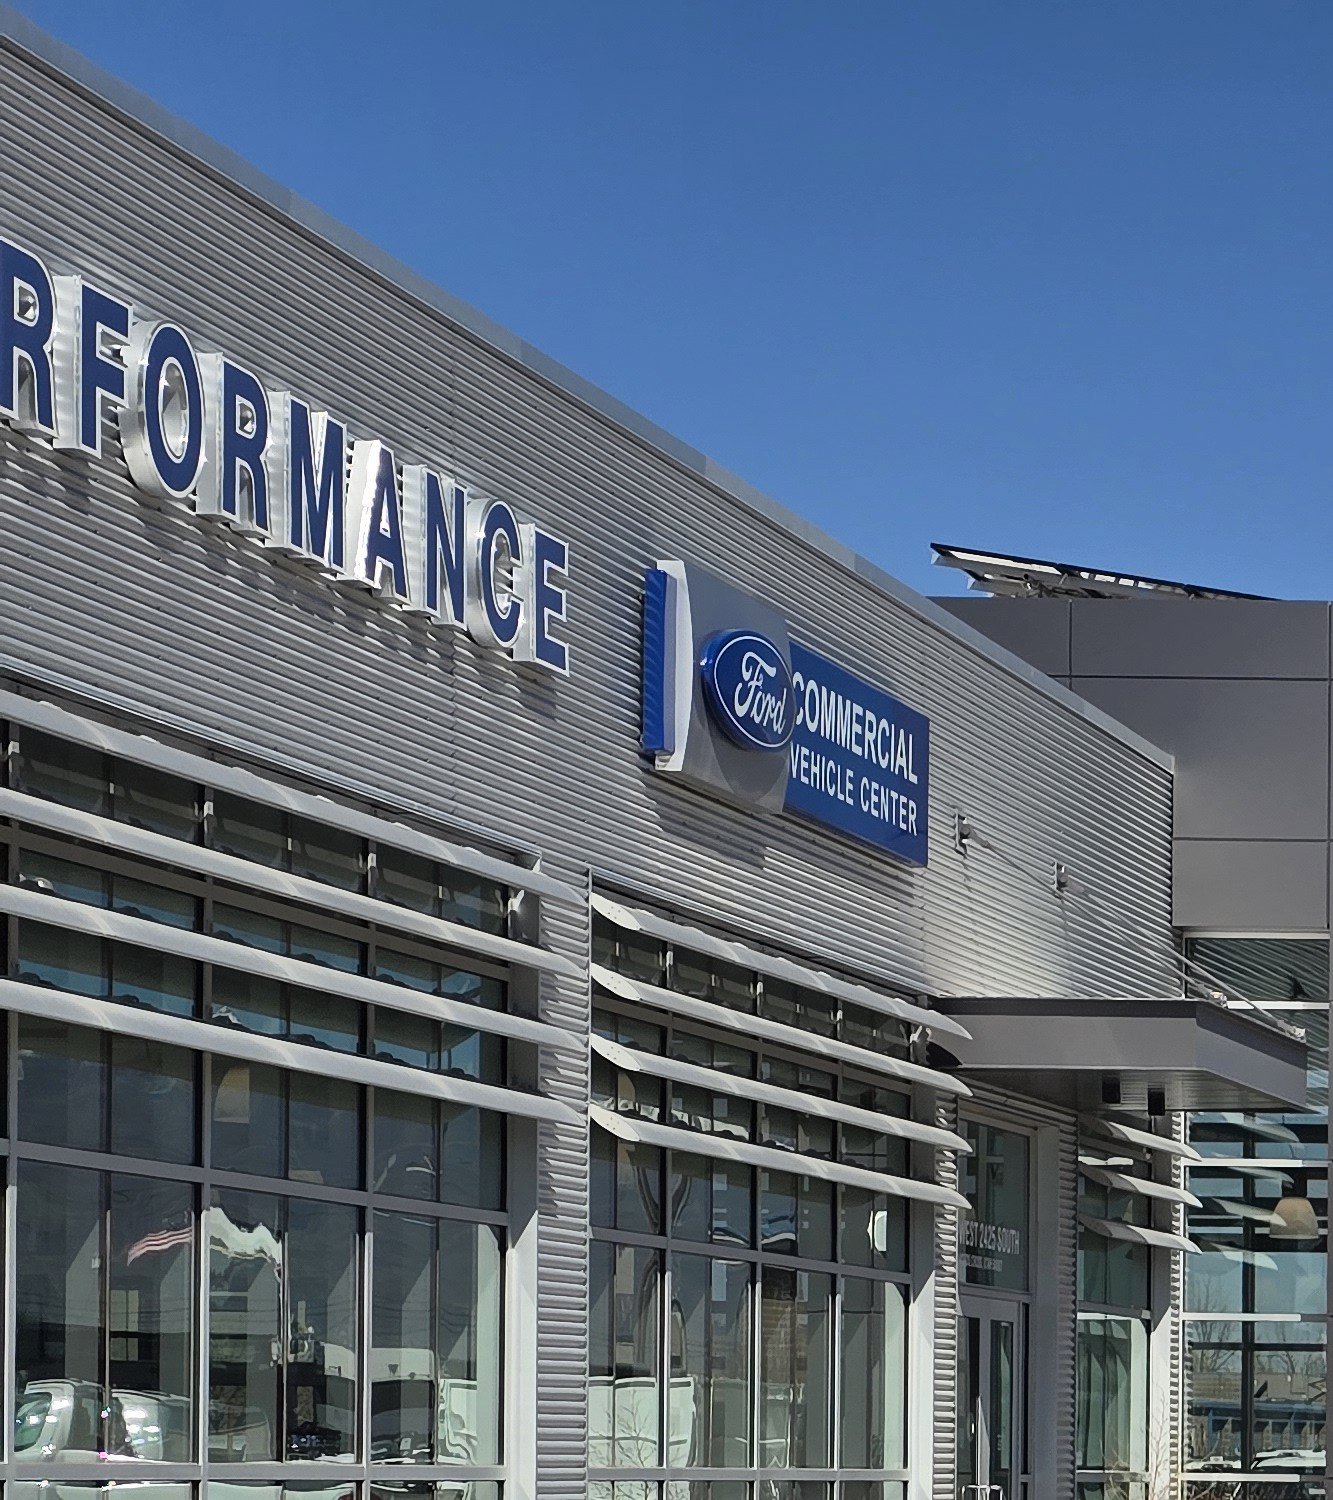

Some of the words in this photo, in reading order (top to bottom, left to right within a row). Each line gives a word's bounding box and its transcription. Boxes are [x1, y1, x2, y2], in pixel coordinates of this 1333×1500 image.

[0, 236, 570, 677] RFORMANCE
[734, 651, 788, 735] Ford
[792, 671, 919, 785] COMMERCIAL
[790, 743, 855, 806] VEHICLE
[860, 776, 918, 837] CENTER
